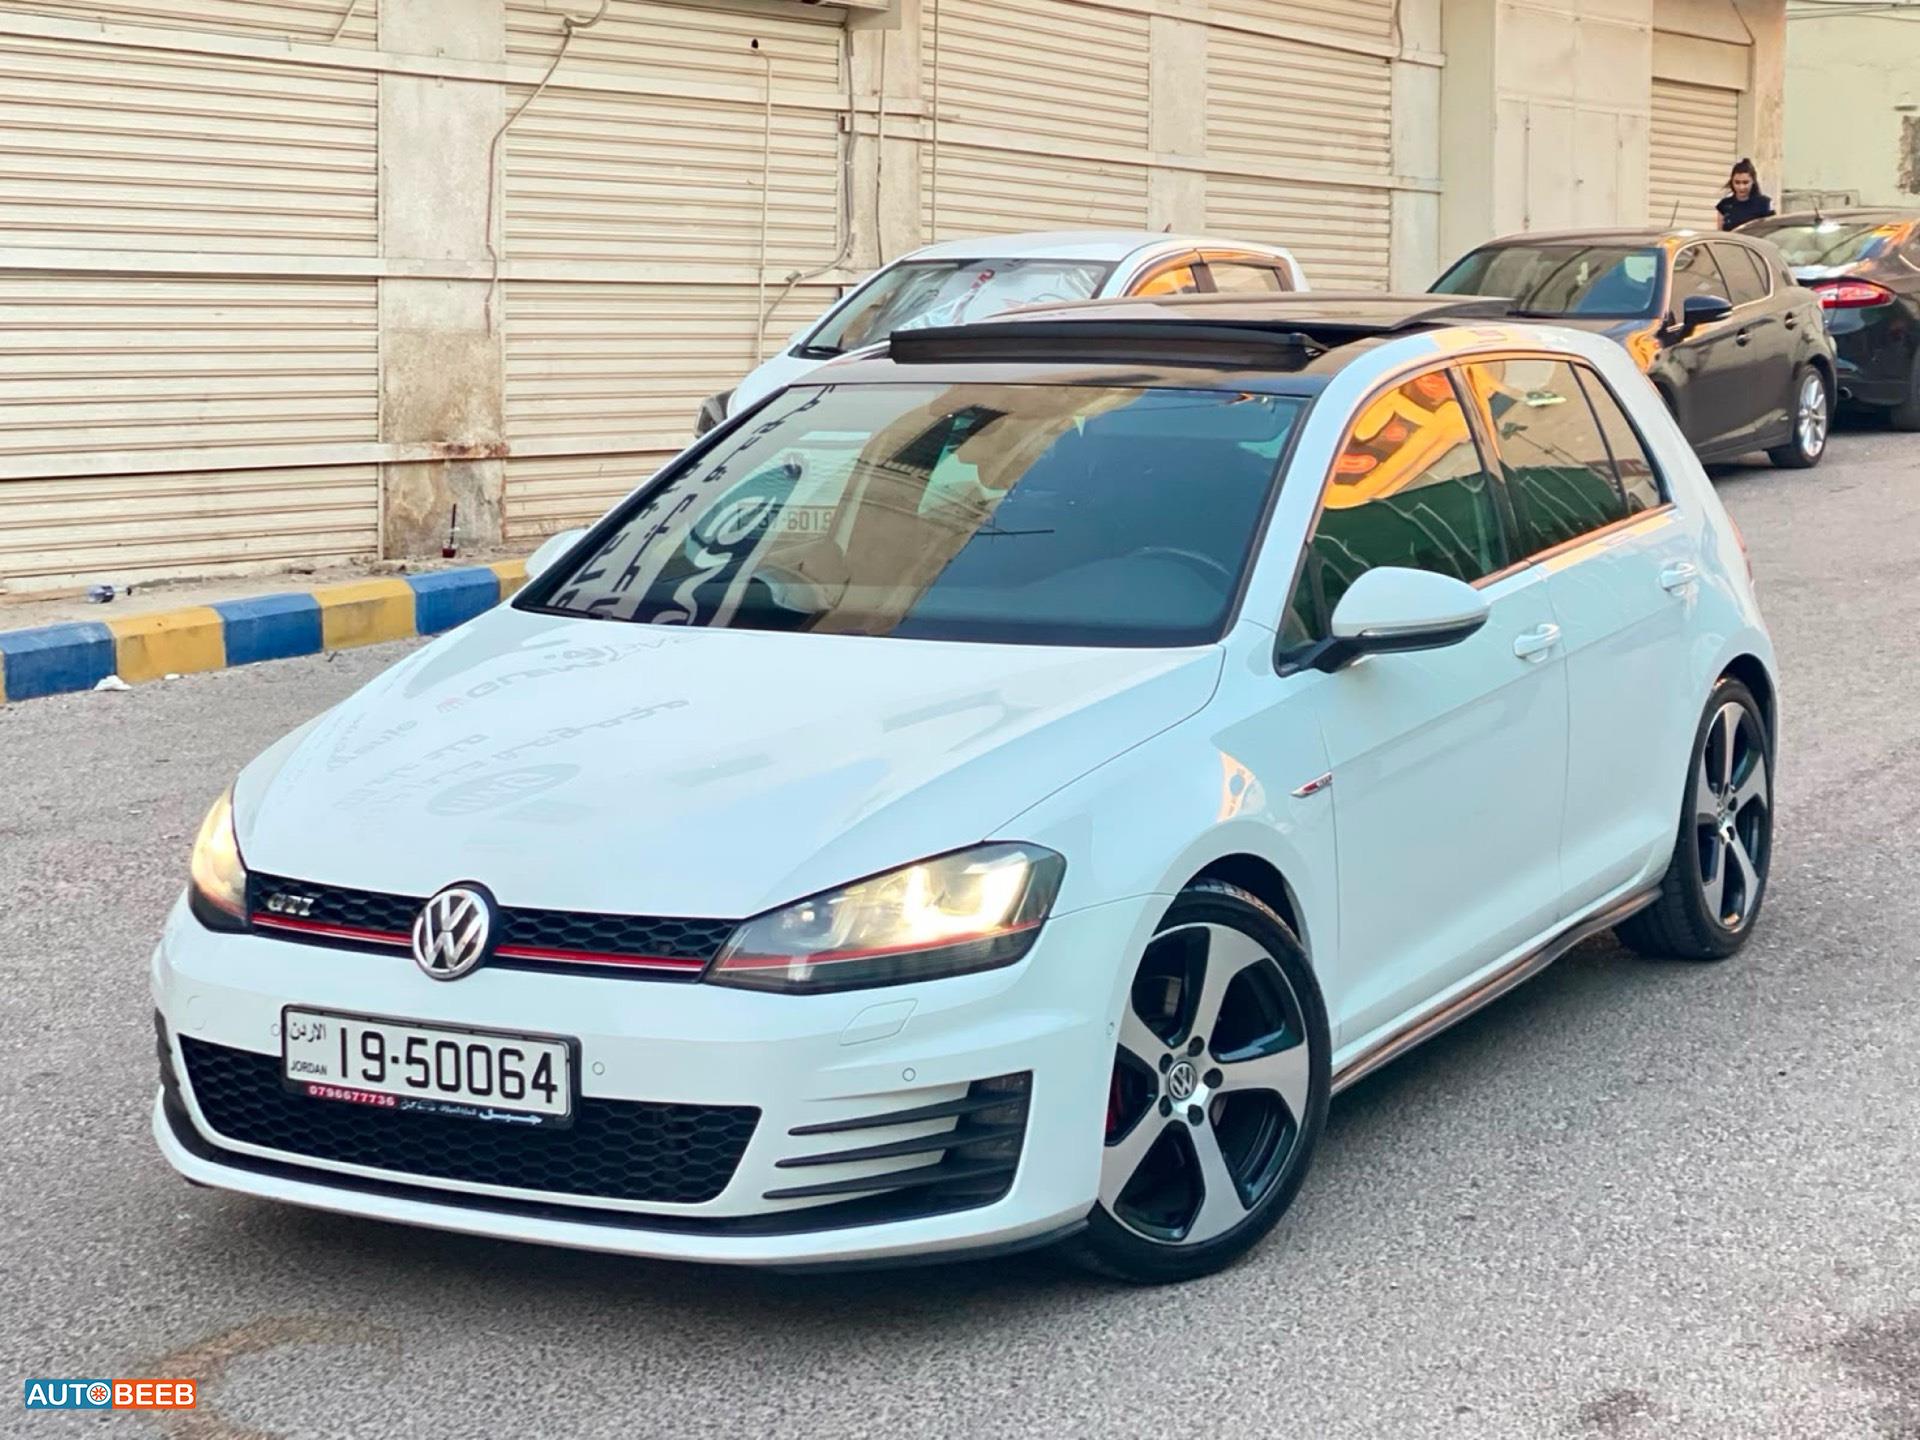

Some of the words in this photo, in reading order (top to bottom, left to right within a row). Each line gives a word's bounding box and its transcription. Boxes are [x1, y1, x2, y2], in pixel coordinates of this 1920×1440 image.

[267, 893, 315, 916] GTI
[290, 1060, 328, 1076] JORDAN
[338, 1027, 558, 1103] 19-50064
